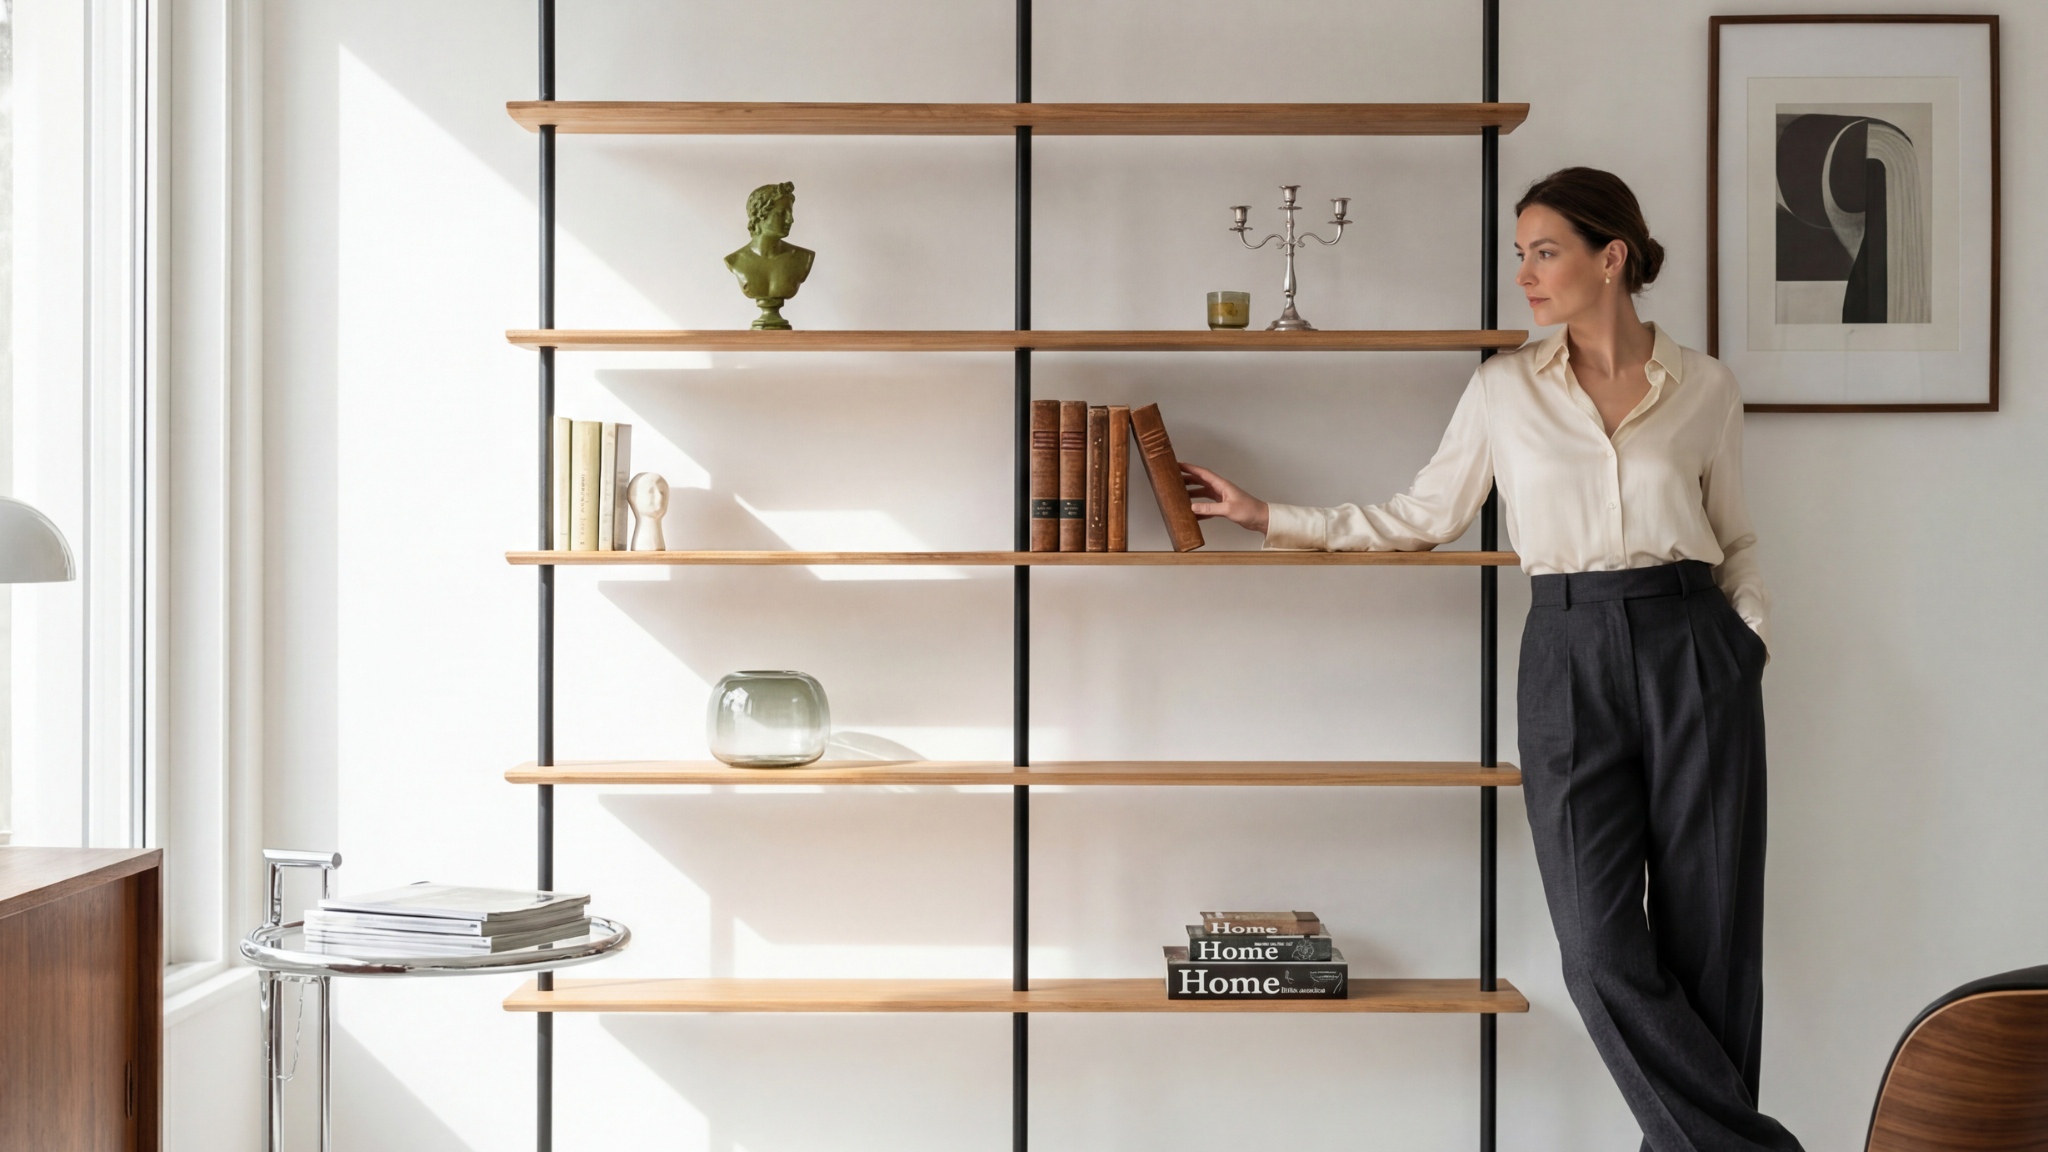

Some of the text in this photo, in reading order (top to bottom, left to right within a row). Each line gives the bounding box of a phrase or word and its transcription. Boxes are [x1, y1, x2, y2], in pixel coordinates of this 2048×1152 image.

[1211, 922, 1278, 934] Home
[1198, 941, 1278, 960] Home
[1178, 969, 1280, 995] Home
